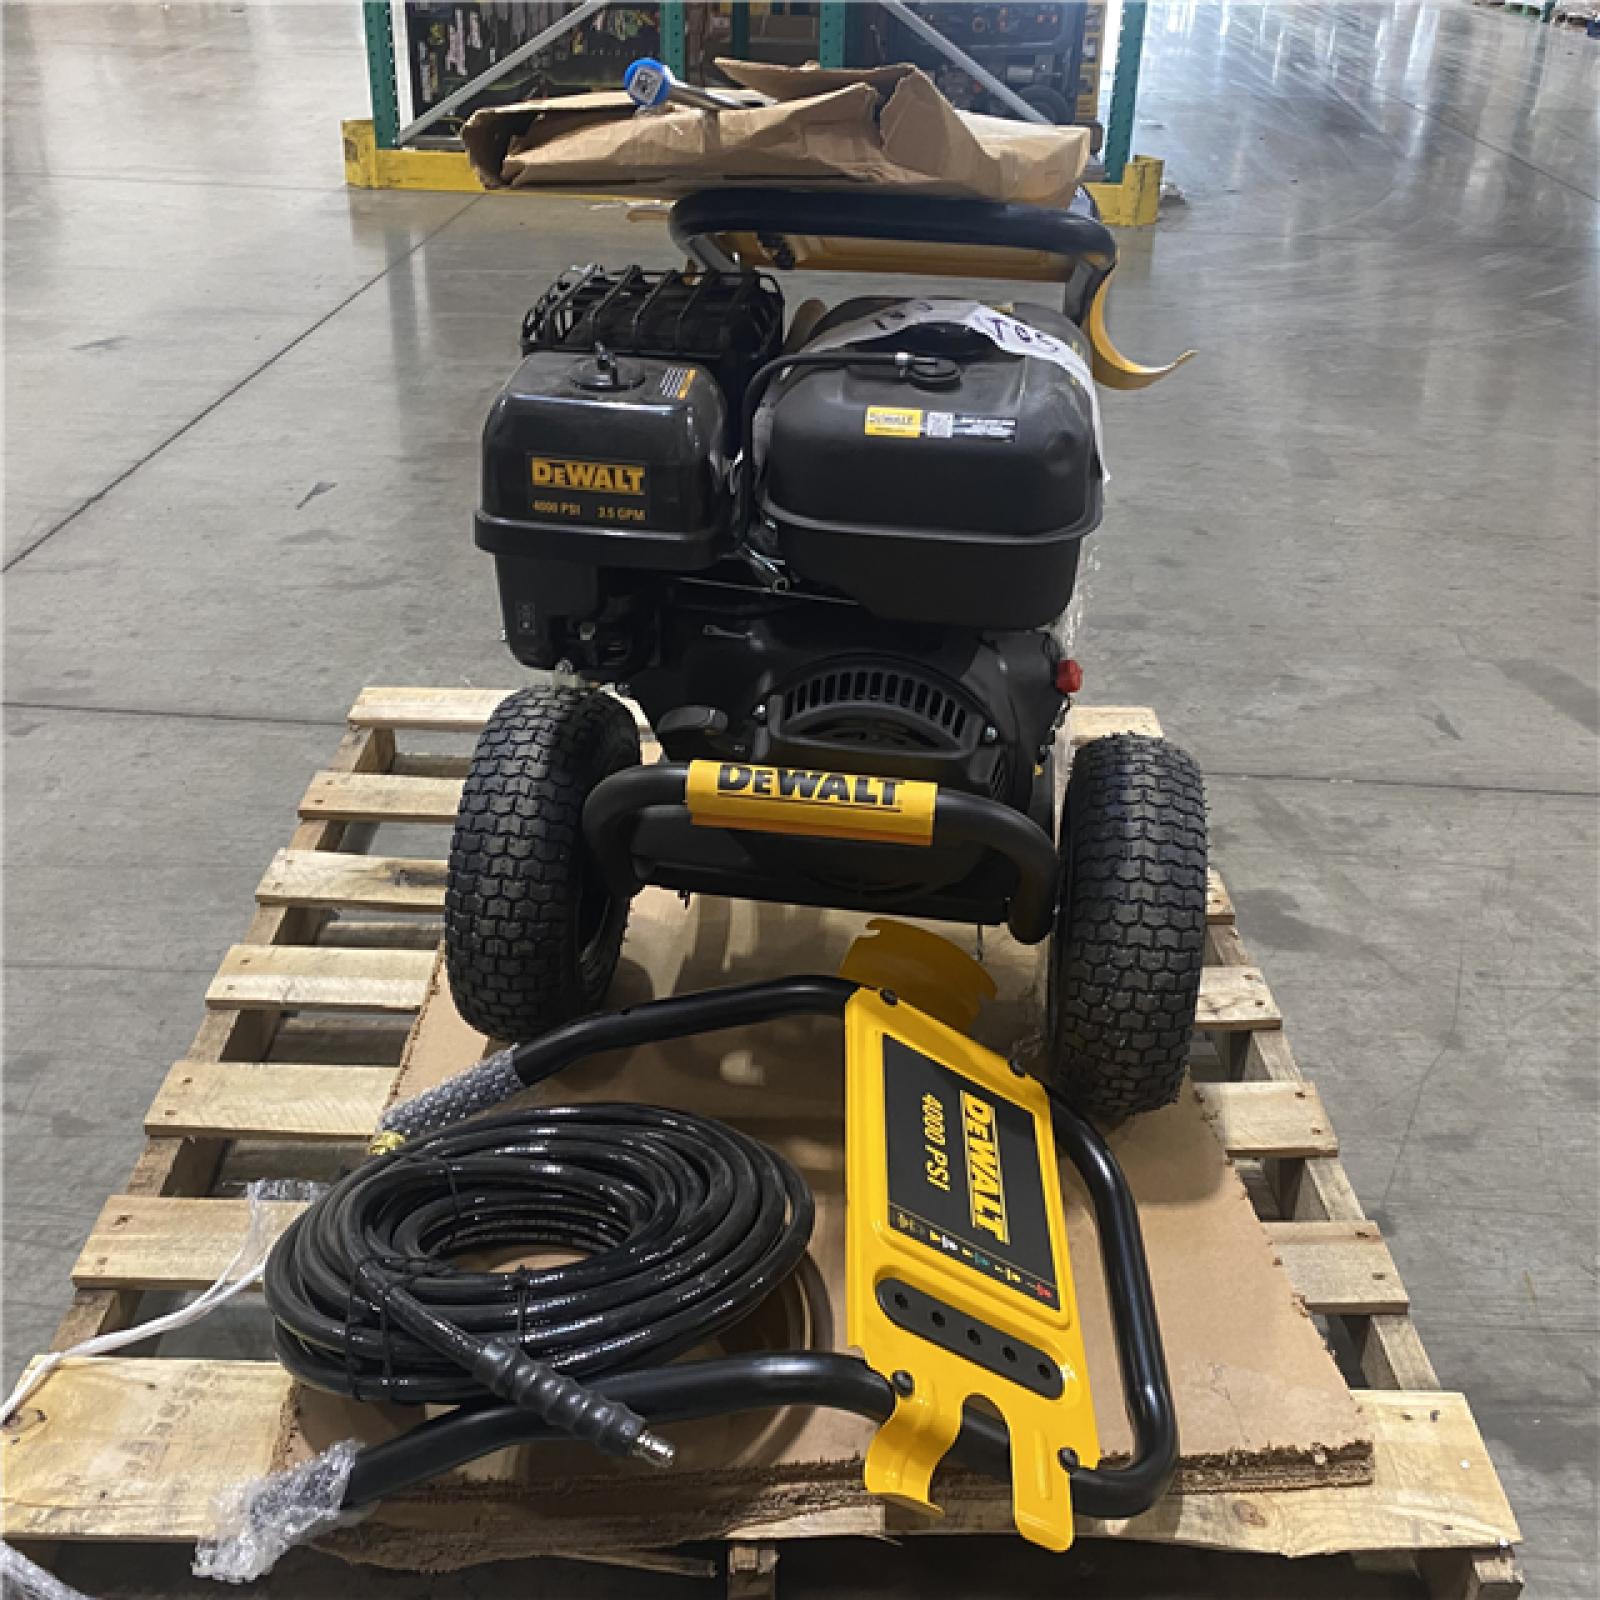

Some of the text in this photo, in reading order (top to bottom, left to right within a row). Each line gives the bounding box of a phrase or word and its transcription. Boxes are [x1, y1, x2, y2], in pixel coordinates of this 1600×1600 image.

[530, 457, 646, 493] DEWALT
[559, 502, 581, 517] PSI
[616, 507, 646, 521] GPM
[718, 763, 905, 807] DEWALT
[921, 1091, 951, 1192] 4000 PSI
[962, 1090, 1008, 1243] DEWALT
